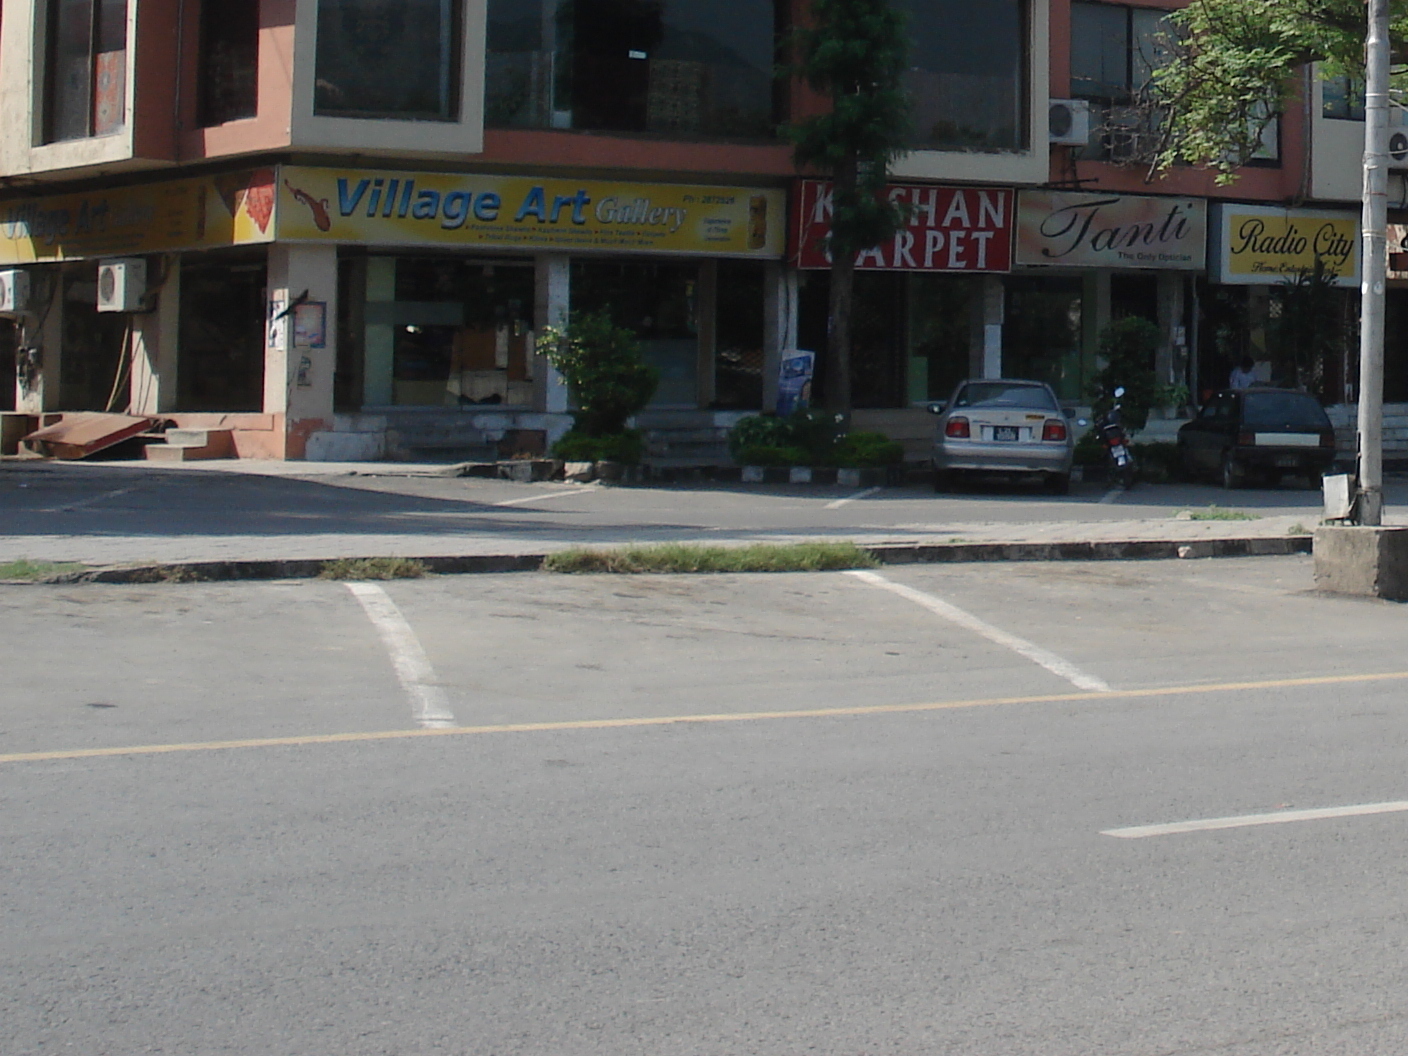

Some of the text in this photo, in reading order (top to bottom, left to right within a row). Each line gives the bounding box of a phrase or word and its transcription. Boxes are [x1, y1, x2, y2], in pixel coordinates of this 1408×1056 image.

[336, 177, 501, 230] Village
[514, 185, 591, 224] Art
[594, 194, 689, 233] Gallery
[814, 183, 1005, 229] KSHAN
[1040, 198, 1194, 258] Tanti
[1118, 251, 1134, 260] The
[1231, 218, 1354, 266] Radio City
